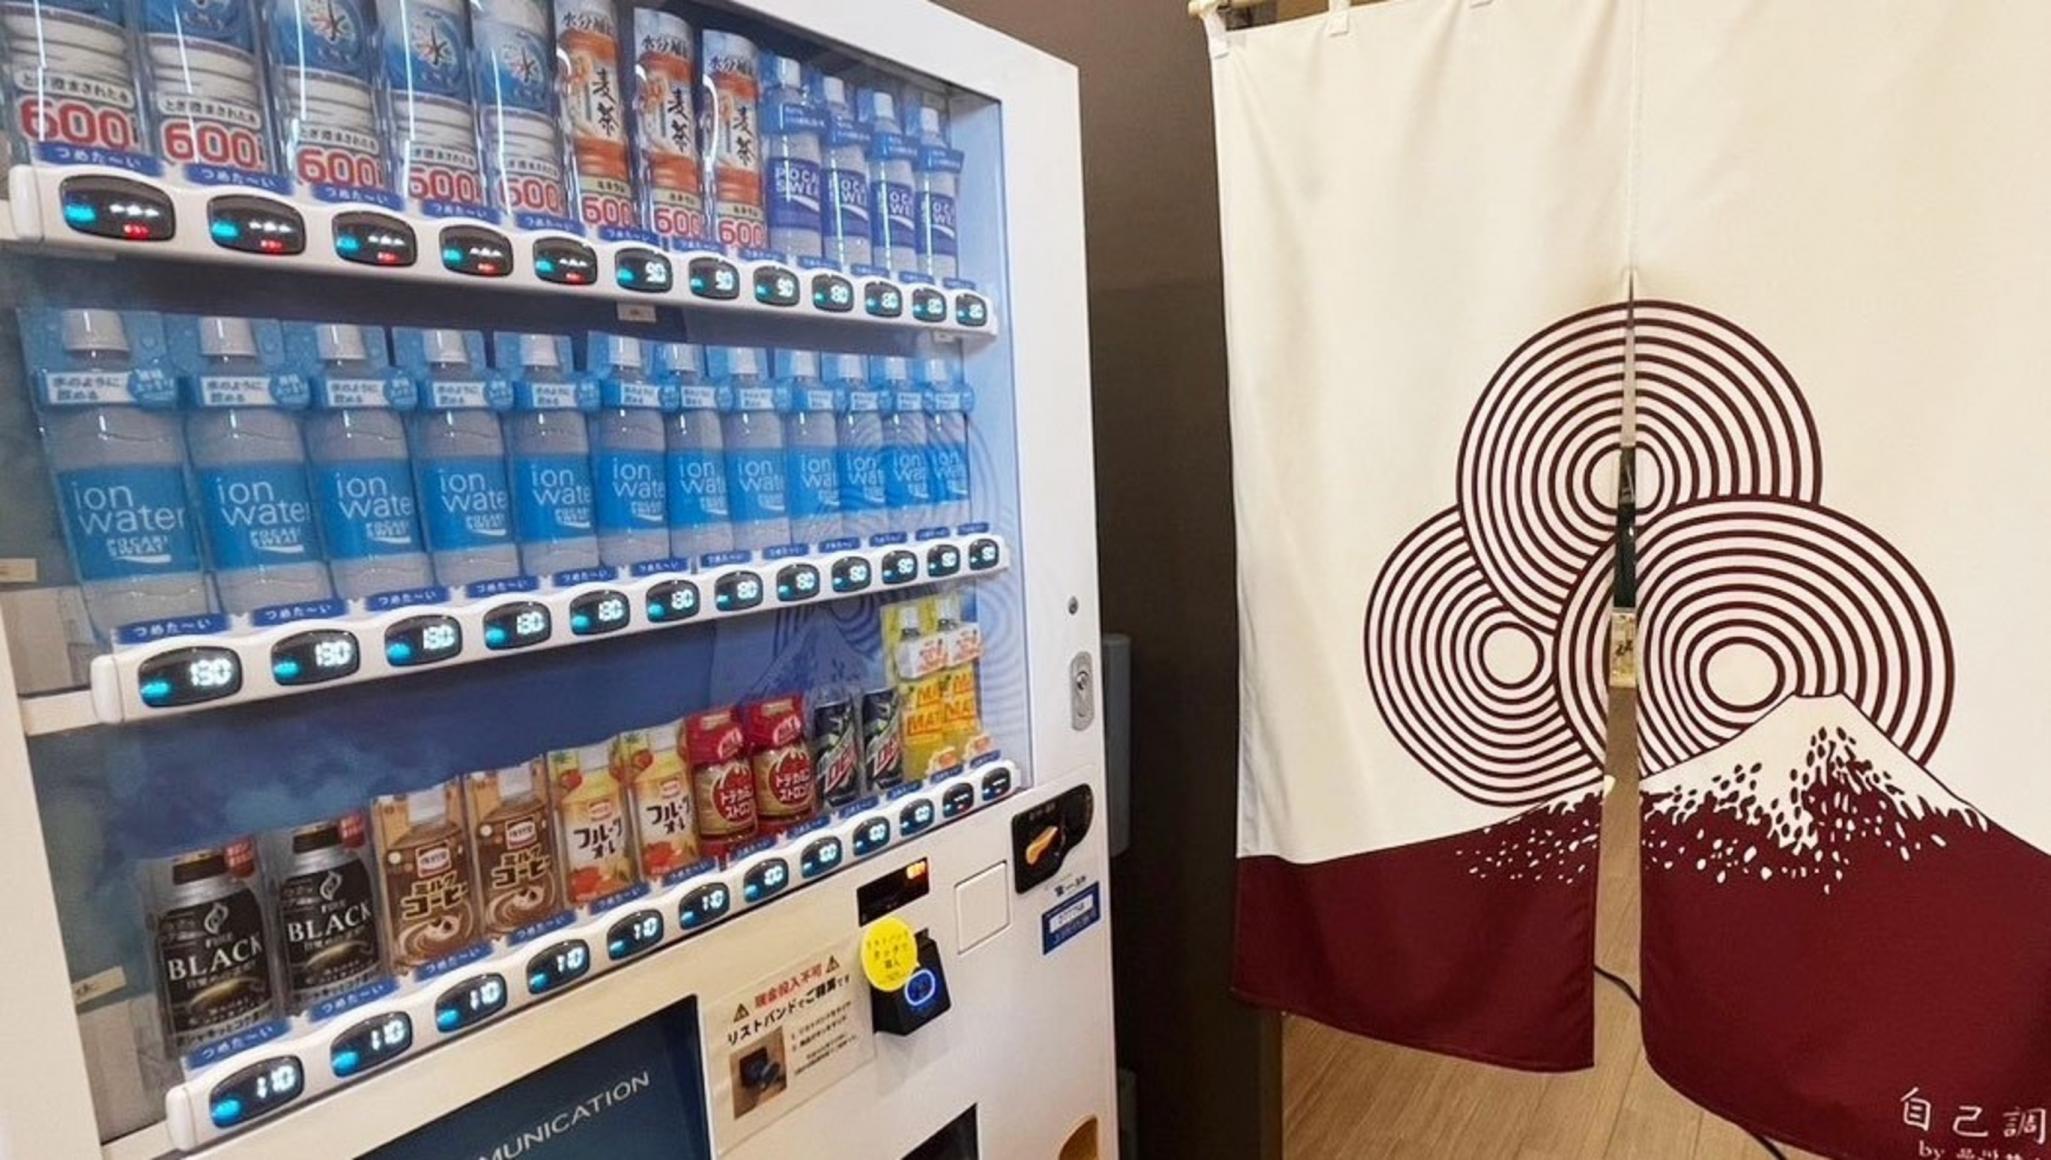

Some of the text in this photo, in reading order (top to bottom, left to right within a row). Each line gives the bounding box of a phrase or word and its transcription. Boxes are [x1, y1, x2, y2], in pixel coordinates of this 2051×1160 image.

[592, 68, 619, 136] 麦茶
[667, 88, 692, 152] 麦茶
[732, 106, 757, 166] 麦茶
[437, 468, 486, 493] ion
[530, 464, 575, 488] ion
[612, 457, 651, 481] ion
[679, 456, 715, 479] ion
[737, 457, 773, 476] ion
[71, 480, 134, 511] ion
[215, 476, 275, 506] ion
[336, 471, 387, 500] ion
[78, 504, 186, 535] water
[423, 623, 455, 650] 130
[314, 639, 353, 667] 130
[190, 658, 233, 687] 130
[501, 844, 542, 867] ミルク
[413, 870, 458, 897] ミルク
[556, 946, 585, 973] 110
[469, 980, 501, 1010] 110
[370, 1019, 406, 1050] 110
[256, 1064, 297, 1099] 110
[1899, 1085, 2047, 1145] 自己調
